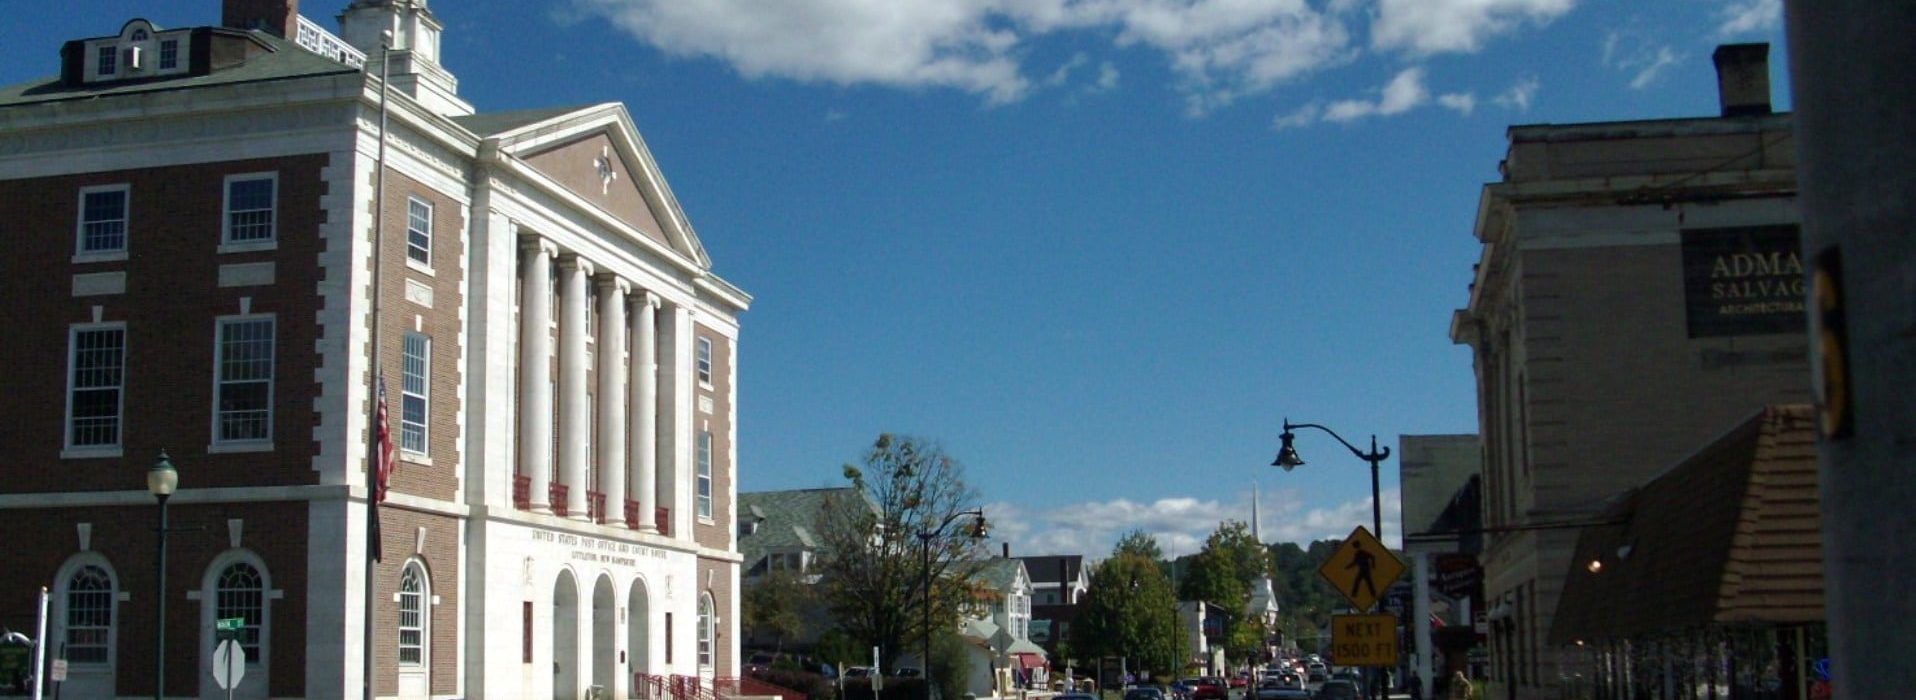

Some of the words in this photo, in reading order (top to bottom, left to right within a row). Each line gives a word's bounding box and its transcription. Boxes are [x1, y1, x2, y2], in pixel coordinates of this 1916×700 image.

[1711, 252, 1803, 278] ADMA
[1712, 279, 1806, 299] SALVAG
[532, 530, 554, 542] UNITED
[558, 534, 577, 546] STATES
[581, 537, 594, 548] POST
[598, 540, 616, 552] OFFICE
[619, 543, 629, 554] AND
[1345, 622, 1381, 638] NEXT
[1336, 642, 1370, 658] 1500
[1376, 642, 1392, 659] FT
